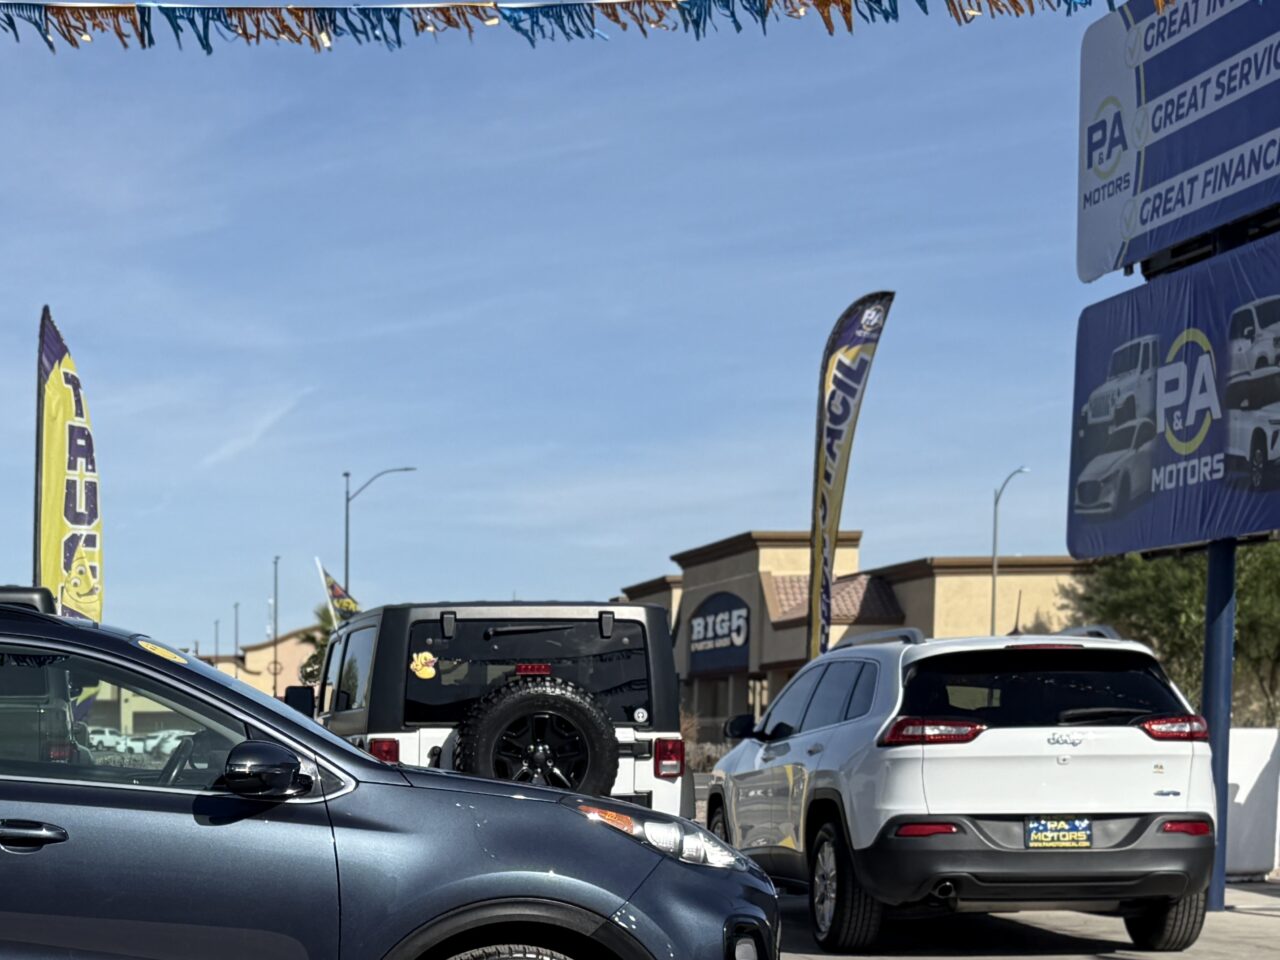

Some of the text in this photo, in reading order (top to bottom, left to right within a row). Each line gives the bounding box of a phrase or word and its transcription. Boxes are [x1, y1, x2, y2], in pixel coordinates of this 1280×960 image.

[1143, 0, 1200, 52] GREAT
[1151, 78, 1212, 133] GREAT
[1083, 172, 1130, 210] MOTORS
[1139, 174, 1198, 226] GREAT
[1150, 452, 1225, 493] MOTORS
[691, 611, 730, 641] BIG
[730, 607, 748, 647] 5
[1030, 831, 1087, 841] MOTORS
